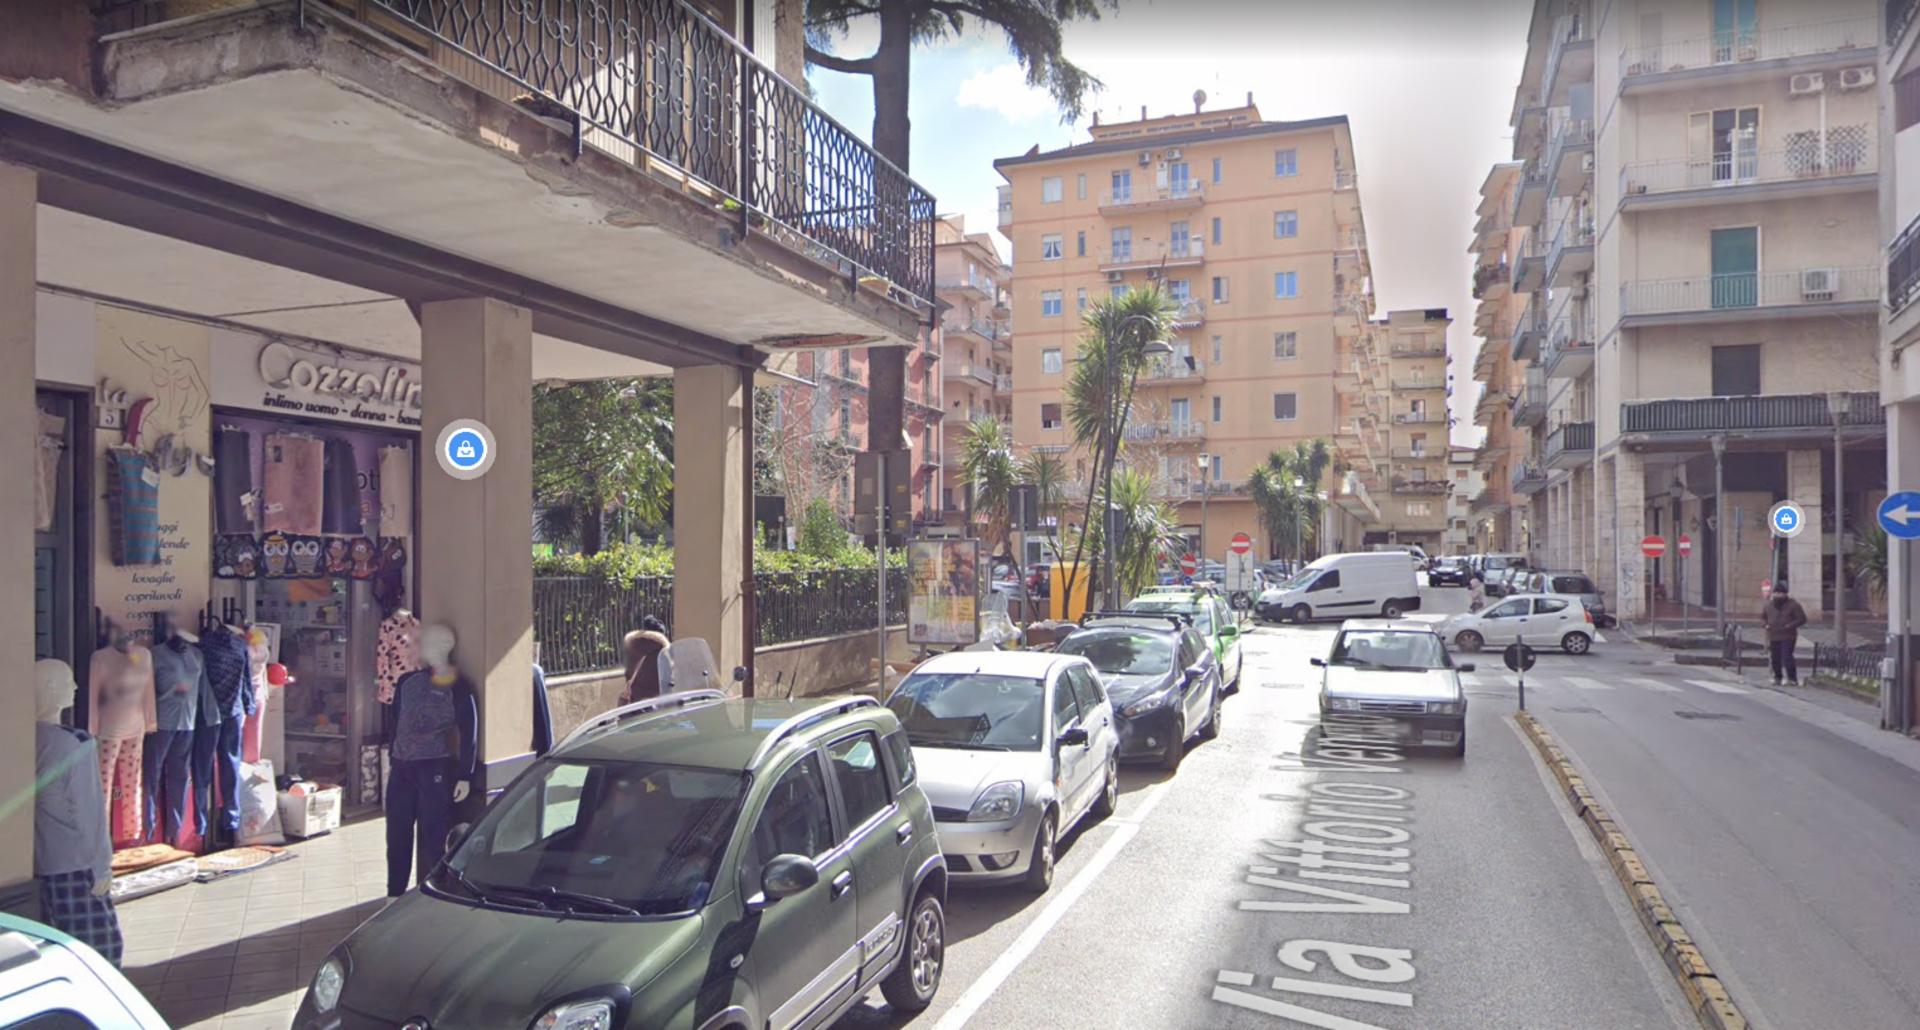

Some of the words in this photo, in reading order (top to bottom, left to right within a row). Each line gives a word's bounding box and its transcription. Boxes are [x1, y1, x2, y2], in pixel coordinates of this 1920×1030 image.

[259, 342, 422, 409] Cozzolin
[263, 392, 303, 410] intimo
[305, 404, 340, 415] uomo
[350, 403, 386, 422] donna
